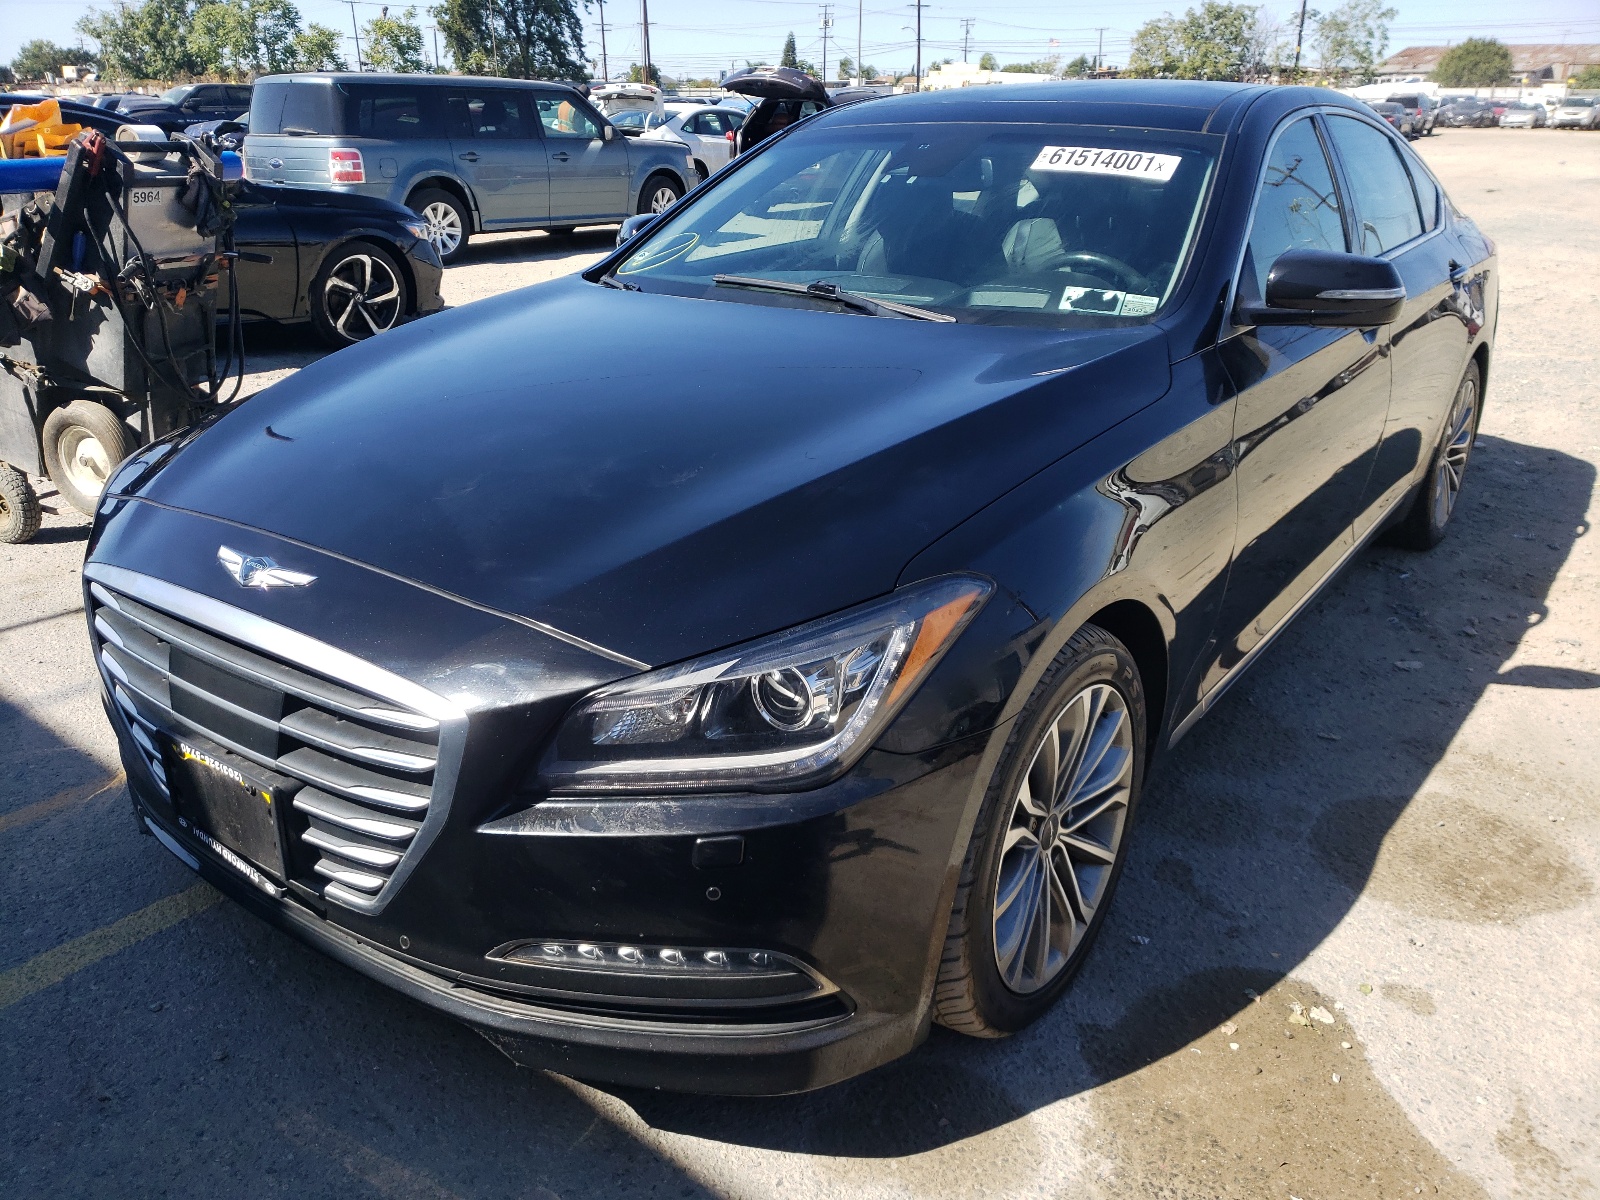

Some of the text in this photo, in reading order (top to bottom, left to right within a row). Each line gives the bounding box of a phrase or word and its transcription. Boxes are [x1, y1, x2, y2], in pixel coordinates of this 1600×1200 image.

[1049, 148, 1156, 172] 61514001
[133, 190, 161, 204] 5964
[192, 826, 259, 883] STAMFORD HYUNDAI
